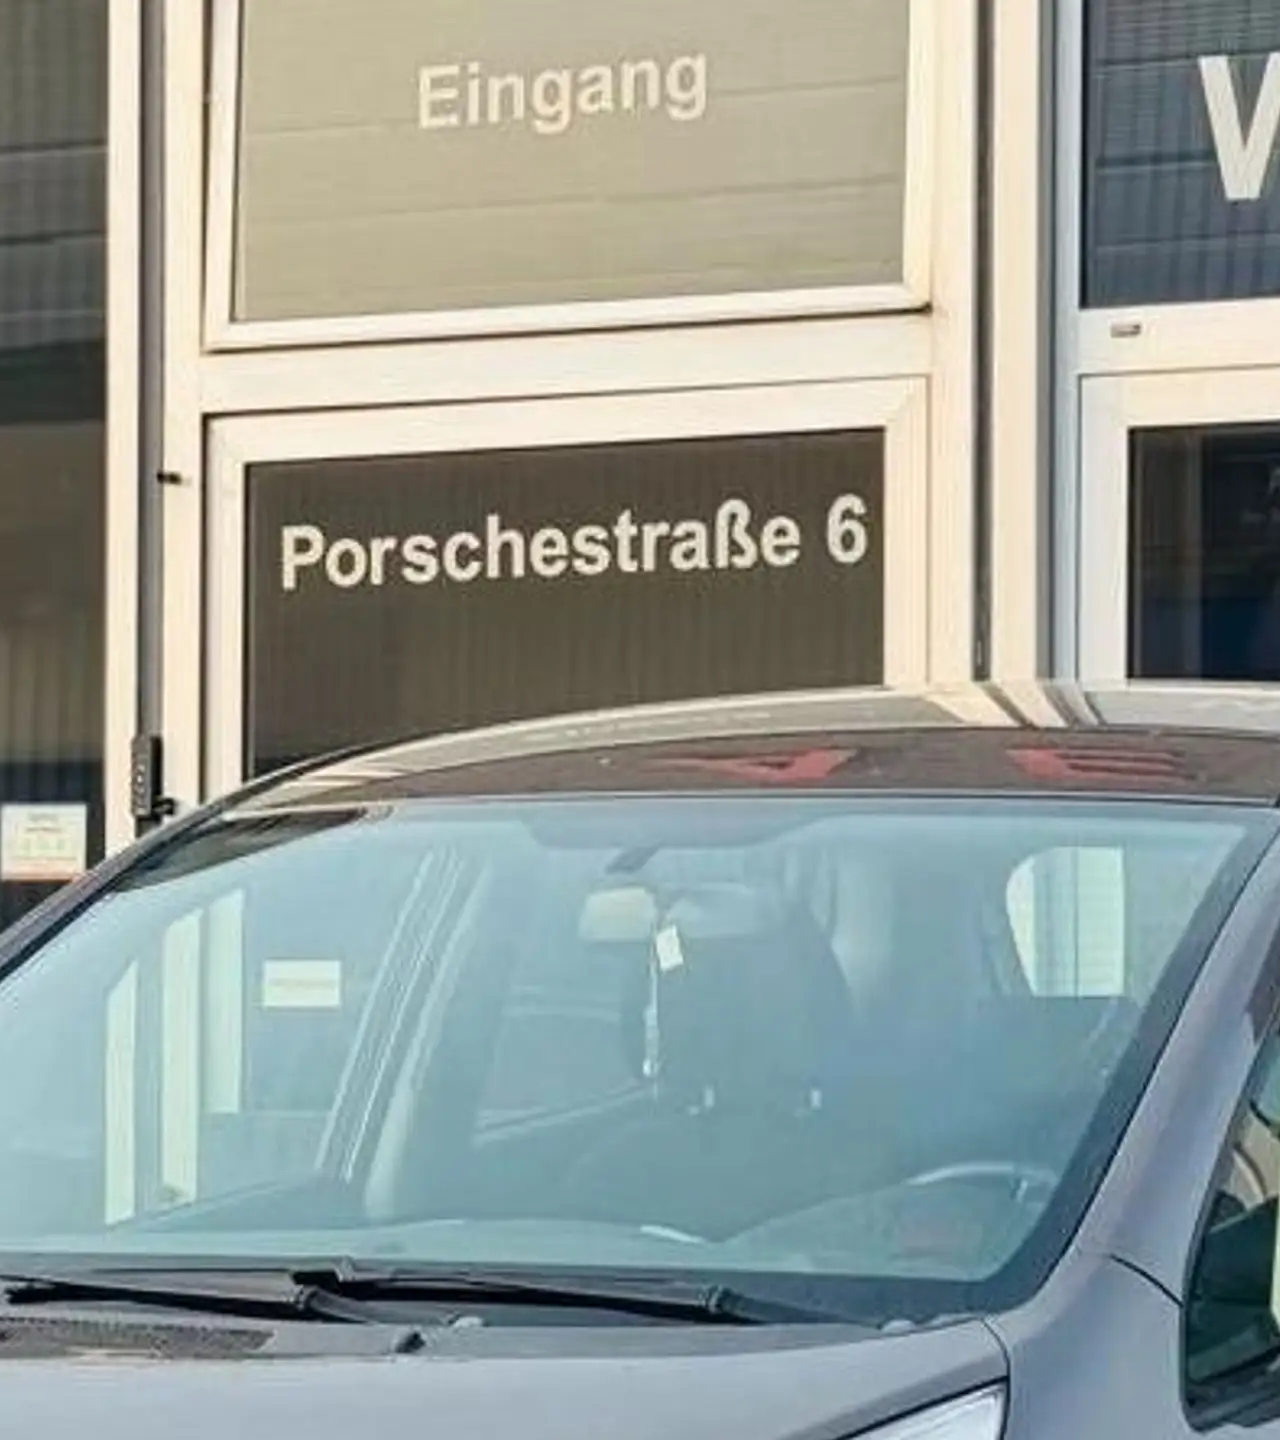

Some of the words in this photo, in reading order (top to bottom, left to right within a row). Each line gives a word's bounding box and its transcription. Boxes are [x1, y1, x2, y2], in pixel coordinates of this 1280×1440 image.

[418, 51, 708, 134] Eingang
[280, 499, 801, 591] Porschestraße
[826, 494, 868, 564] 6
